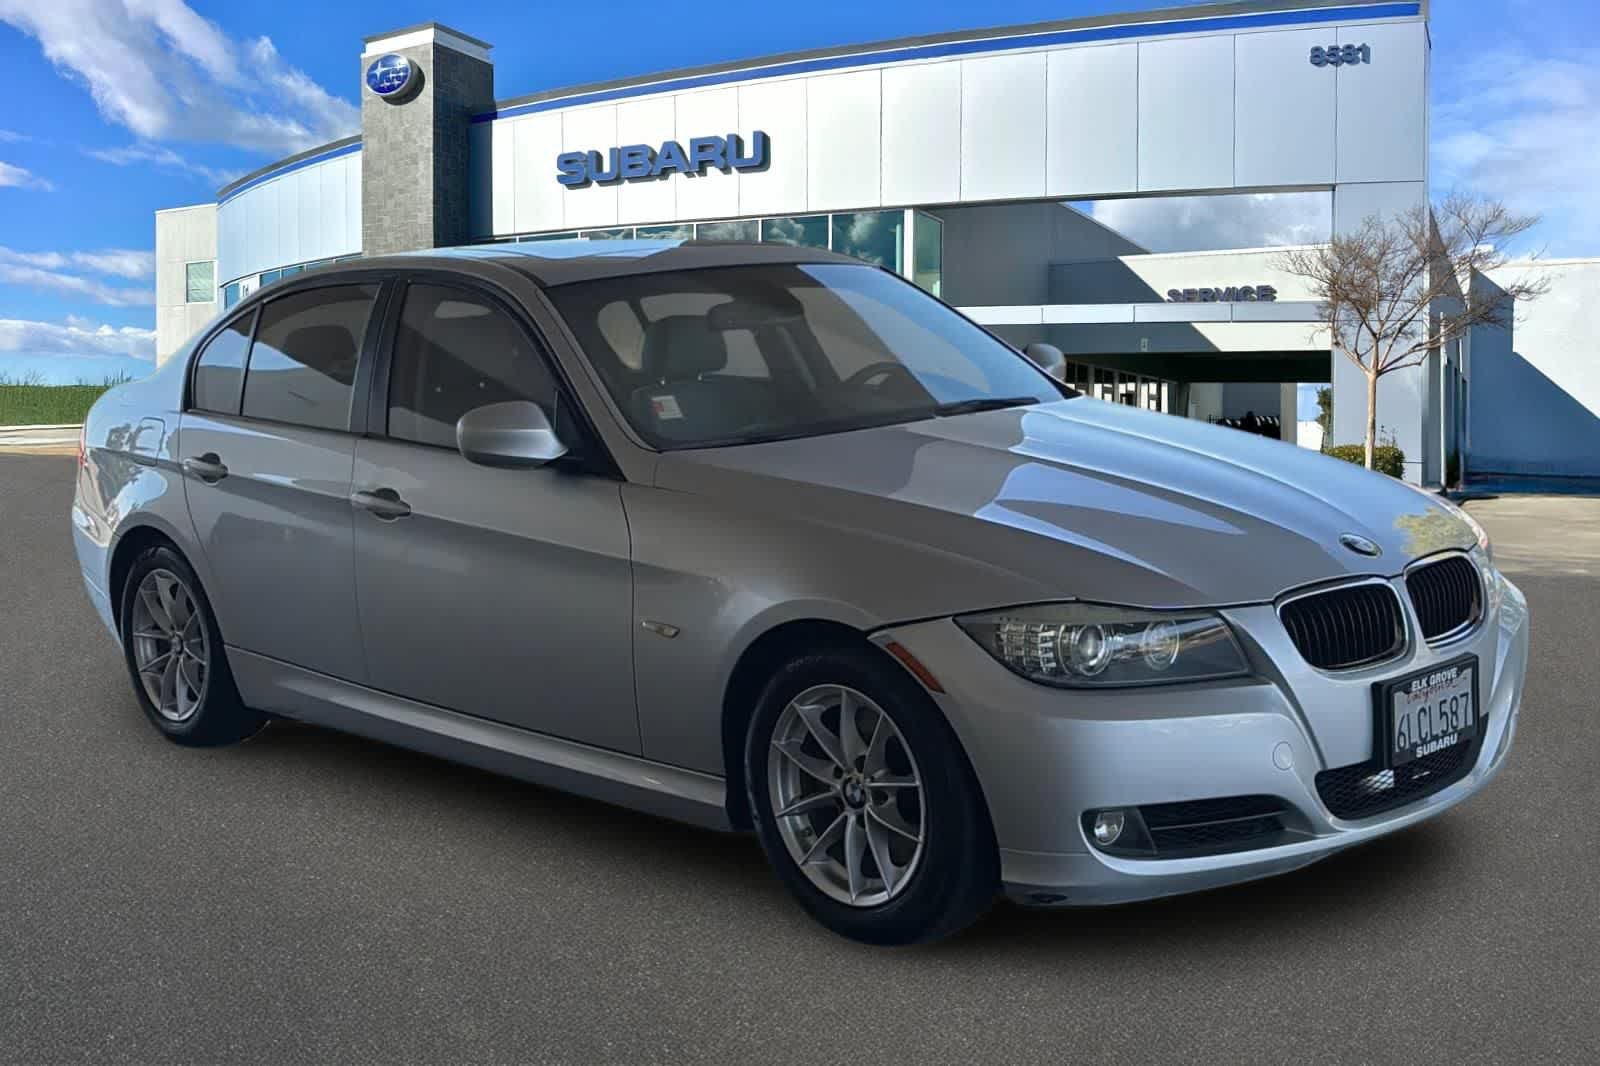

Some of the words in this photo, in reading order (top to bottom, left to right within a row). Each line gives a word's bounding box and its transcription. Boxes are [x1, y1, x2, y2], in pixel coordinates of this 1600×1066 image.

[556, 130, 769, 189] SUBARU
[1167, 285, 1277, 303] SERVICE
[1411, 679, 1429, 691] ELK
[1430, 667, 1458, 686] GROVE
[1397, 692, 1470, 750] 6LCL587
[1416, 732, 1458, 758] SUBARU
